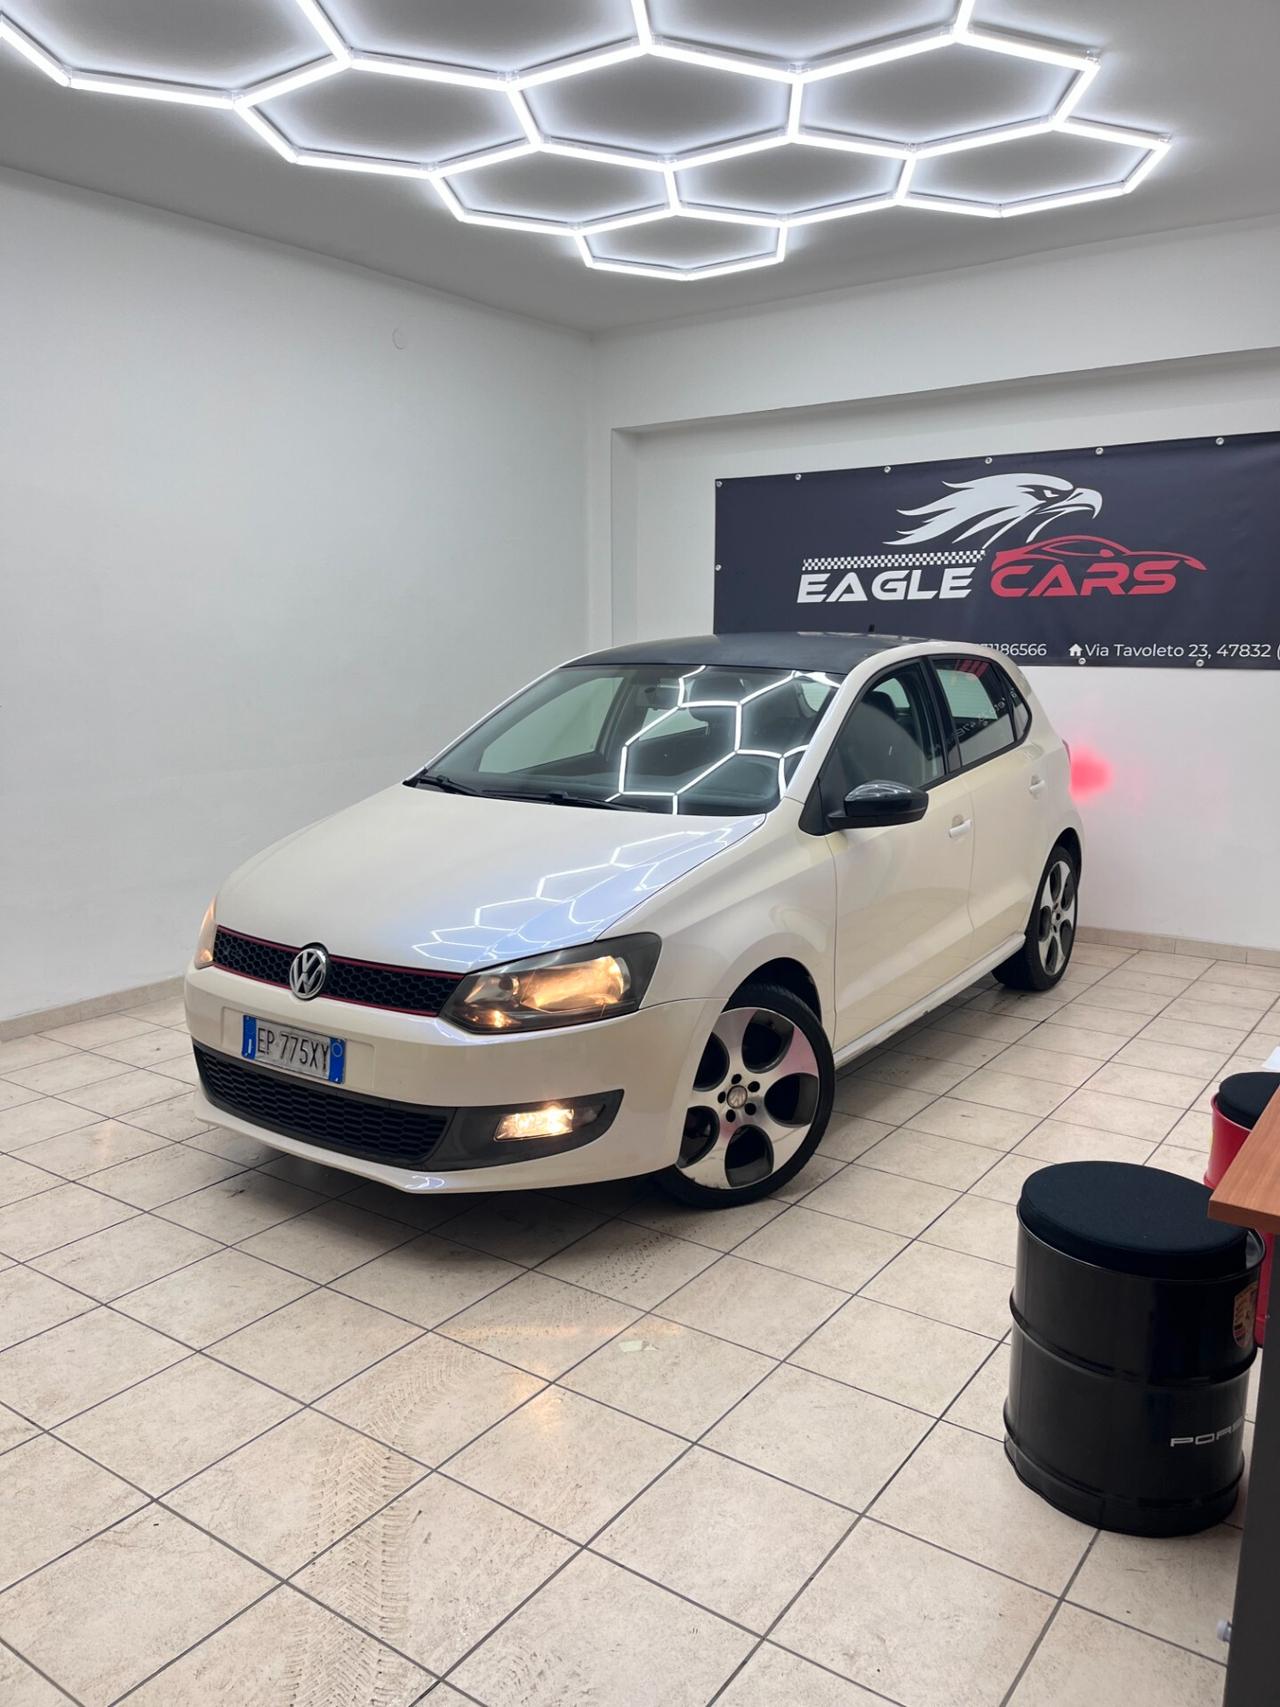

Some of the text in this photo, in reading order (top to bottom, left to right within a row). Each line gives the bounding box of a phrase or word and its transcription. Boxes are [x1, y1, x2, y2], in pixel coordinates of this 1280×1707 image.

[797, 560, 1181, 603] EAGLE CARS
[1085, 643, 1109, 657] Via
[1113, 643, 1184, 657] Tavoleto
[1188, 644, 1212, 659] 23,
[1216, 644, 1272, 657] 47832
[257, 1027, 329, 1071] EP 775XY
